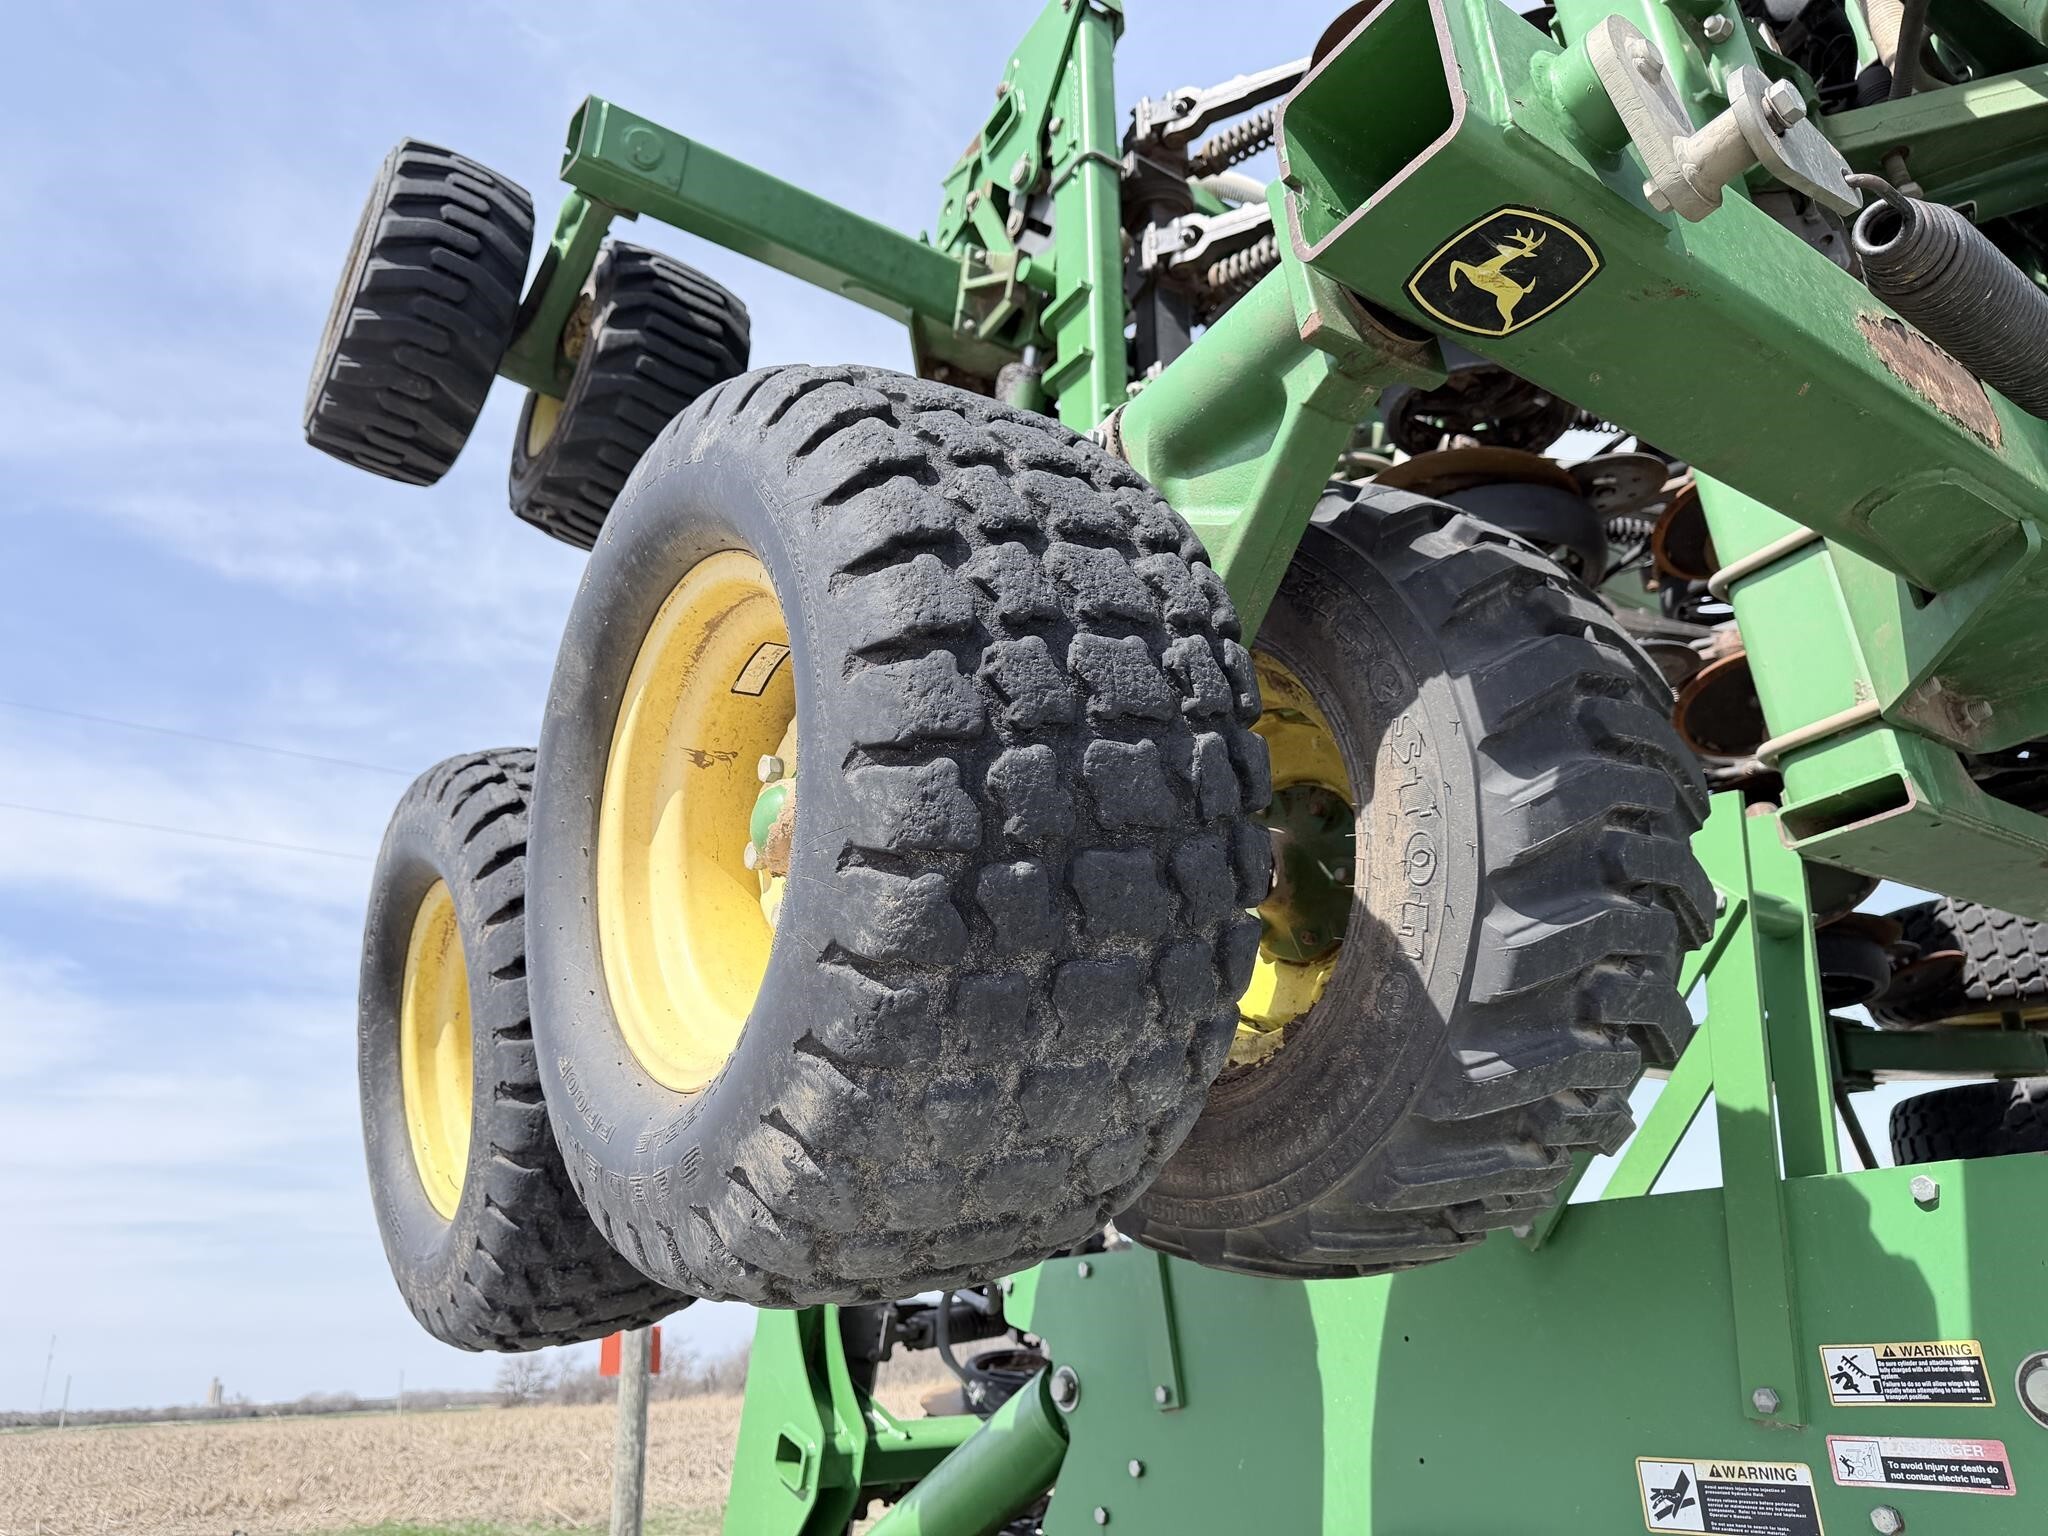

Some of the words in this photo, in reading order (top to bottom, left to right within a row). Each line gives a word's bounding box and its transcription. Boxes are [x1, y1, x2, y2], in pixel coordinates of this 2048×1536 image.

[557, 1055, 617, 1144] PROOF
[1899, 1344, 1973, 1357] WARNING
[1721, 1465, 1798, 1482] WARNING
[1887, 1461, 1899, 1469] To
[1900, 1462, 1923, 1471] avoid
[1924, 1462, 1948, 1473] injury
[1950, 1464, 1960, 1472] or
[1961, 1463, 1986, 1474] death
[1987, 1465, 1999, 1474] do
[1890, 1472, 1905, 1480] not
[1905, 1472, 1936, 1482] contact
[1938, 1474, 1969, 1483] electric
[1970, 1475, 1992, 1485] lines
